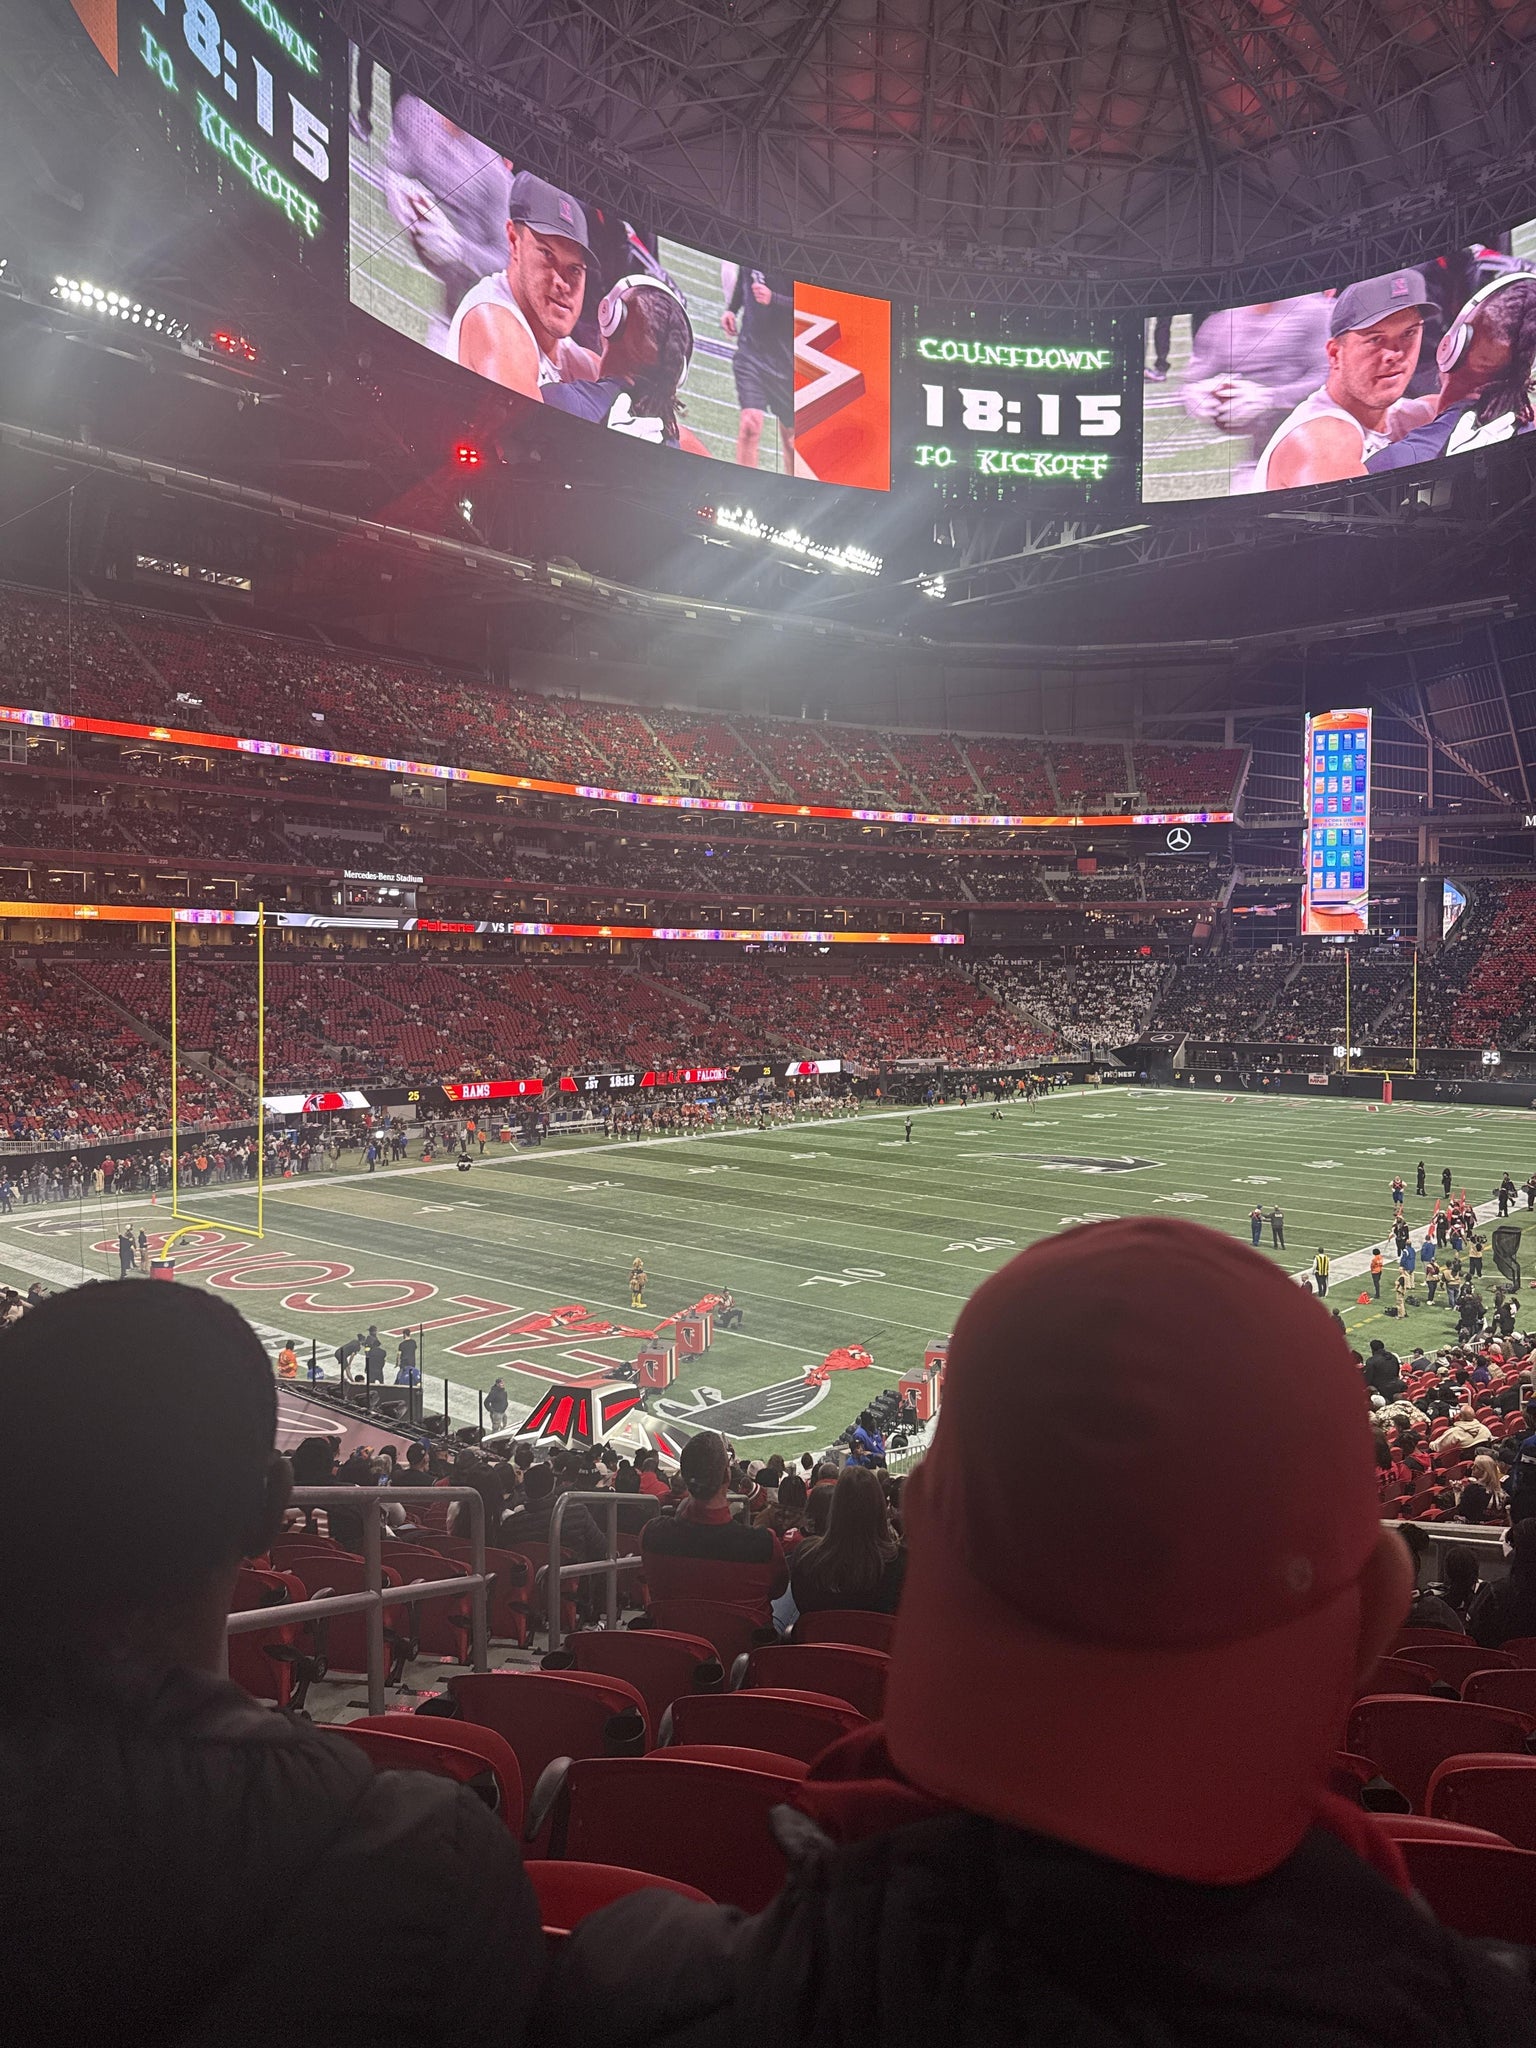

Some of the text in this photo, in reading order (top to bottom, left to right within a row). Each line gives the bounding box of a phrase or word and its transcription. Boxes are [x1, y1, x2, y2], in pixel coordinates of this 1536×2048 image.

[140, 24, 319, 238] TO KICKOFF
[917, 338, 1109, 370] COUNTDOWN
[922, 384, 1121, 436] 18:15
[915, 446, 1108, 479] TO KICKOFF
[344, 869, 395, 881] Mercedes-Benz
[396, 873, 424, 883] Stadium
[417, 919, 475, 933] Falcons
[491, 922, 505, 933] VS
[1333, 1046, 1361, 1058] 18:14
[1482, 1051, 1499, 1065] 25
[462, 1082, 526, 1098] RAMS 0
[585, 1074, 635, 1090] 1ST 18:15
[407, 1091, 420, 1101] 25
[949, 1236, 1016, 1253] 20
[806, 1267, 887, 1287] 10
